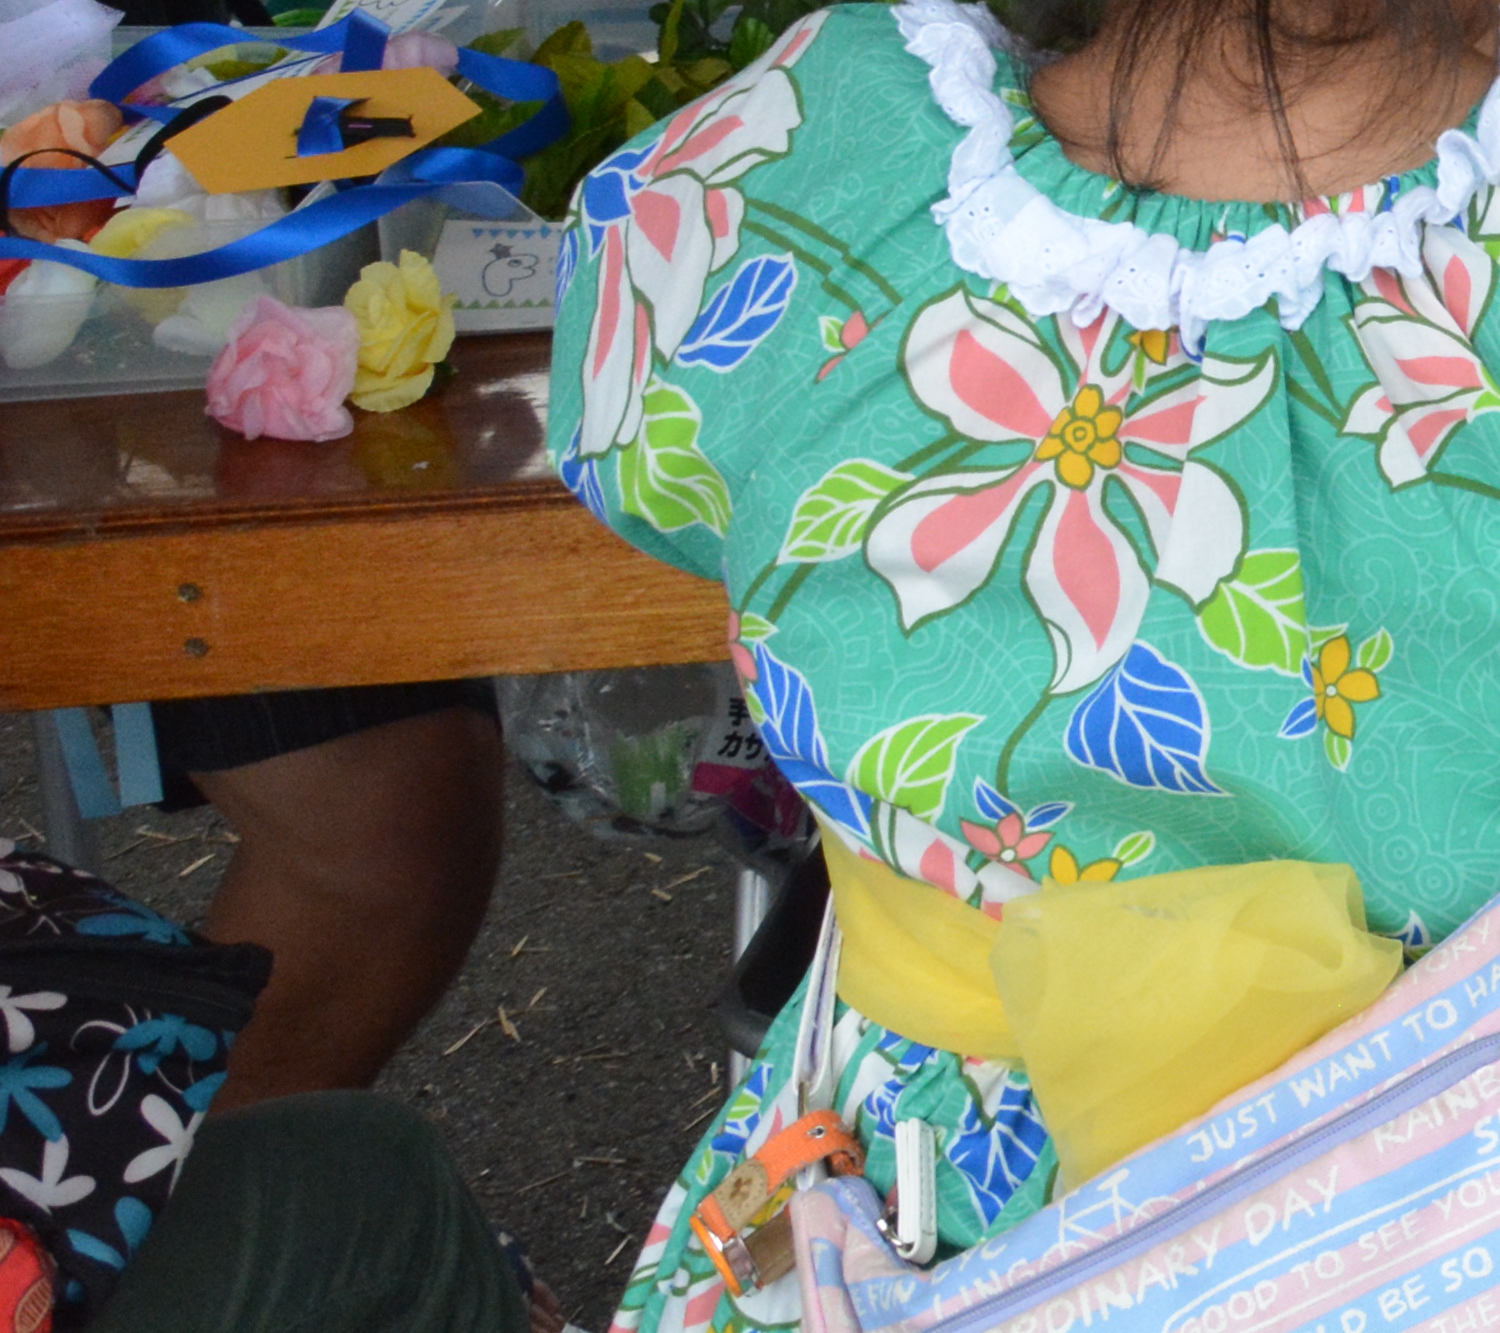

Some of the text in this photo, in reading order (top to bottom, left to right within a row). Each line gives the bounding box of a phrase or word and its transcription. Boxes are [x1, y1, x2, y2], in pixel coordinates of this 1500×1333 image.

[1187, 1093, 1278, 1163] JUST
[1290, 1030, 1393, 1107] WANT
[1402, 998, 1458, 1042] TO
[1244, 1164, 1339, 1247] DAY
[1181, 1280, 1278, 1333] GOOD
[1289, 1249, 1346, 1289] TO
[1357, 1209, 1420, 1262] SEE
[1377, 1274, 1431, 1323] BE
[1440, 1246, 1494, 1293] SO
